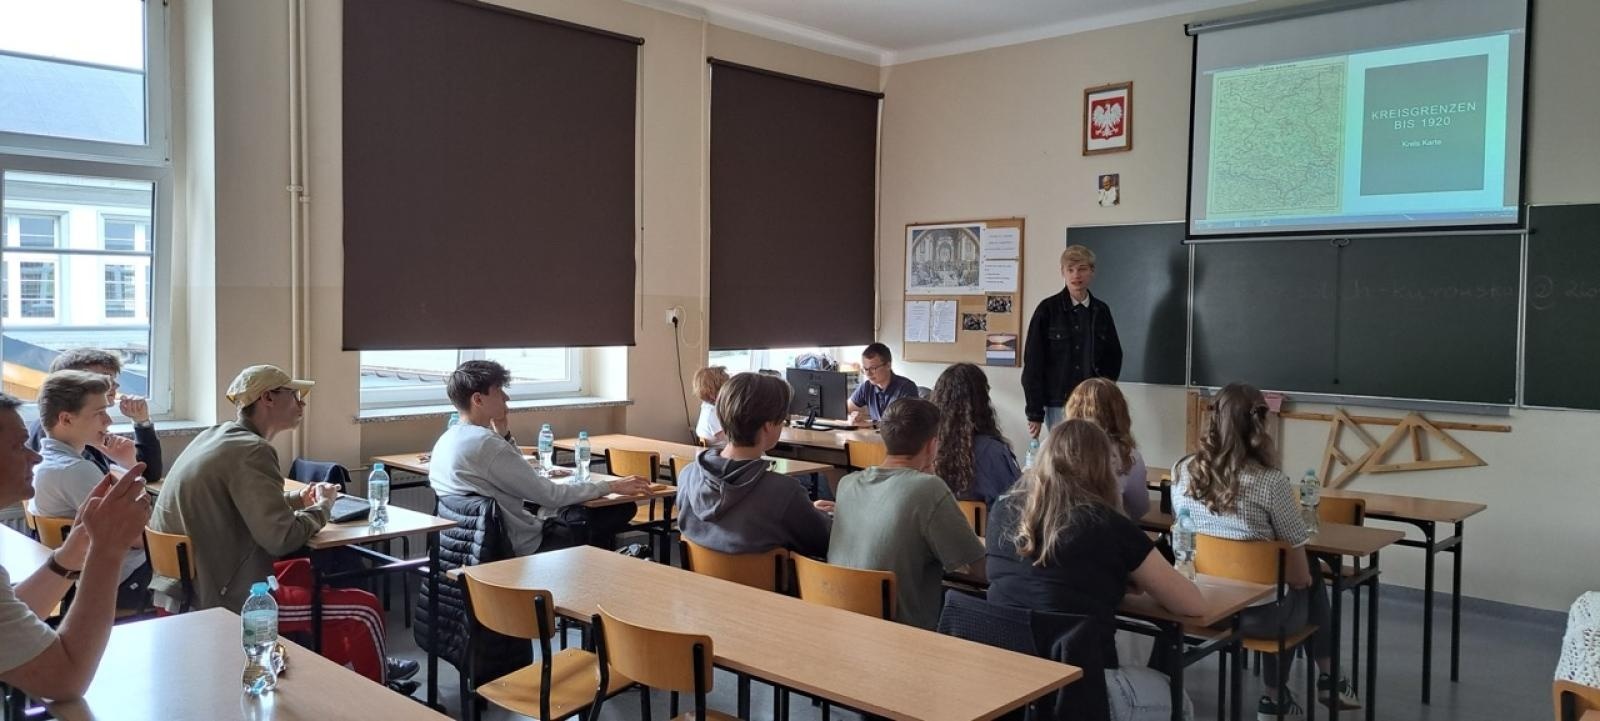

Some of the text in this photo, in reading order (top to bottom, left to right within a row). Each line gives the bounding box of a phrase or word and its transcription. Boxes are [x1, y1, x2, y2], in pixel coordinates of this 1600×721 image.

[1371, 102, 1476, 120] KREISGRENZEN
[1394, 116, 1451, 130] BIS 1920
[1422, 139, 1442, 147] Karte
